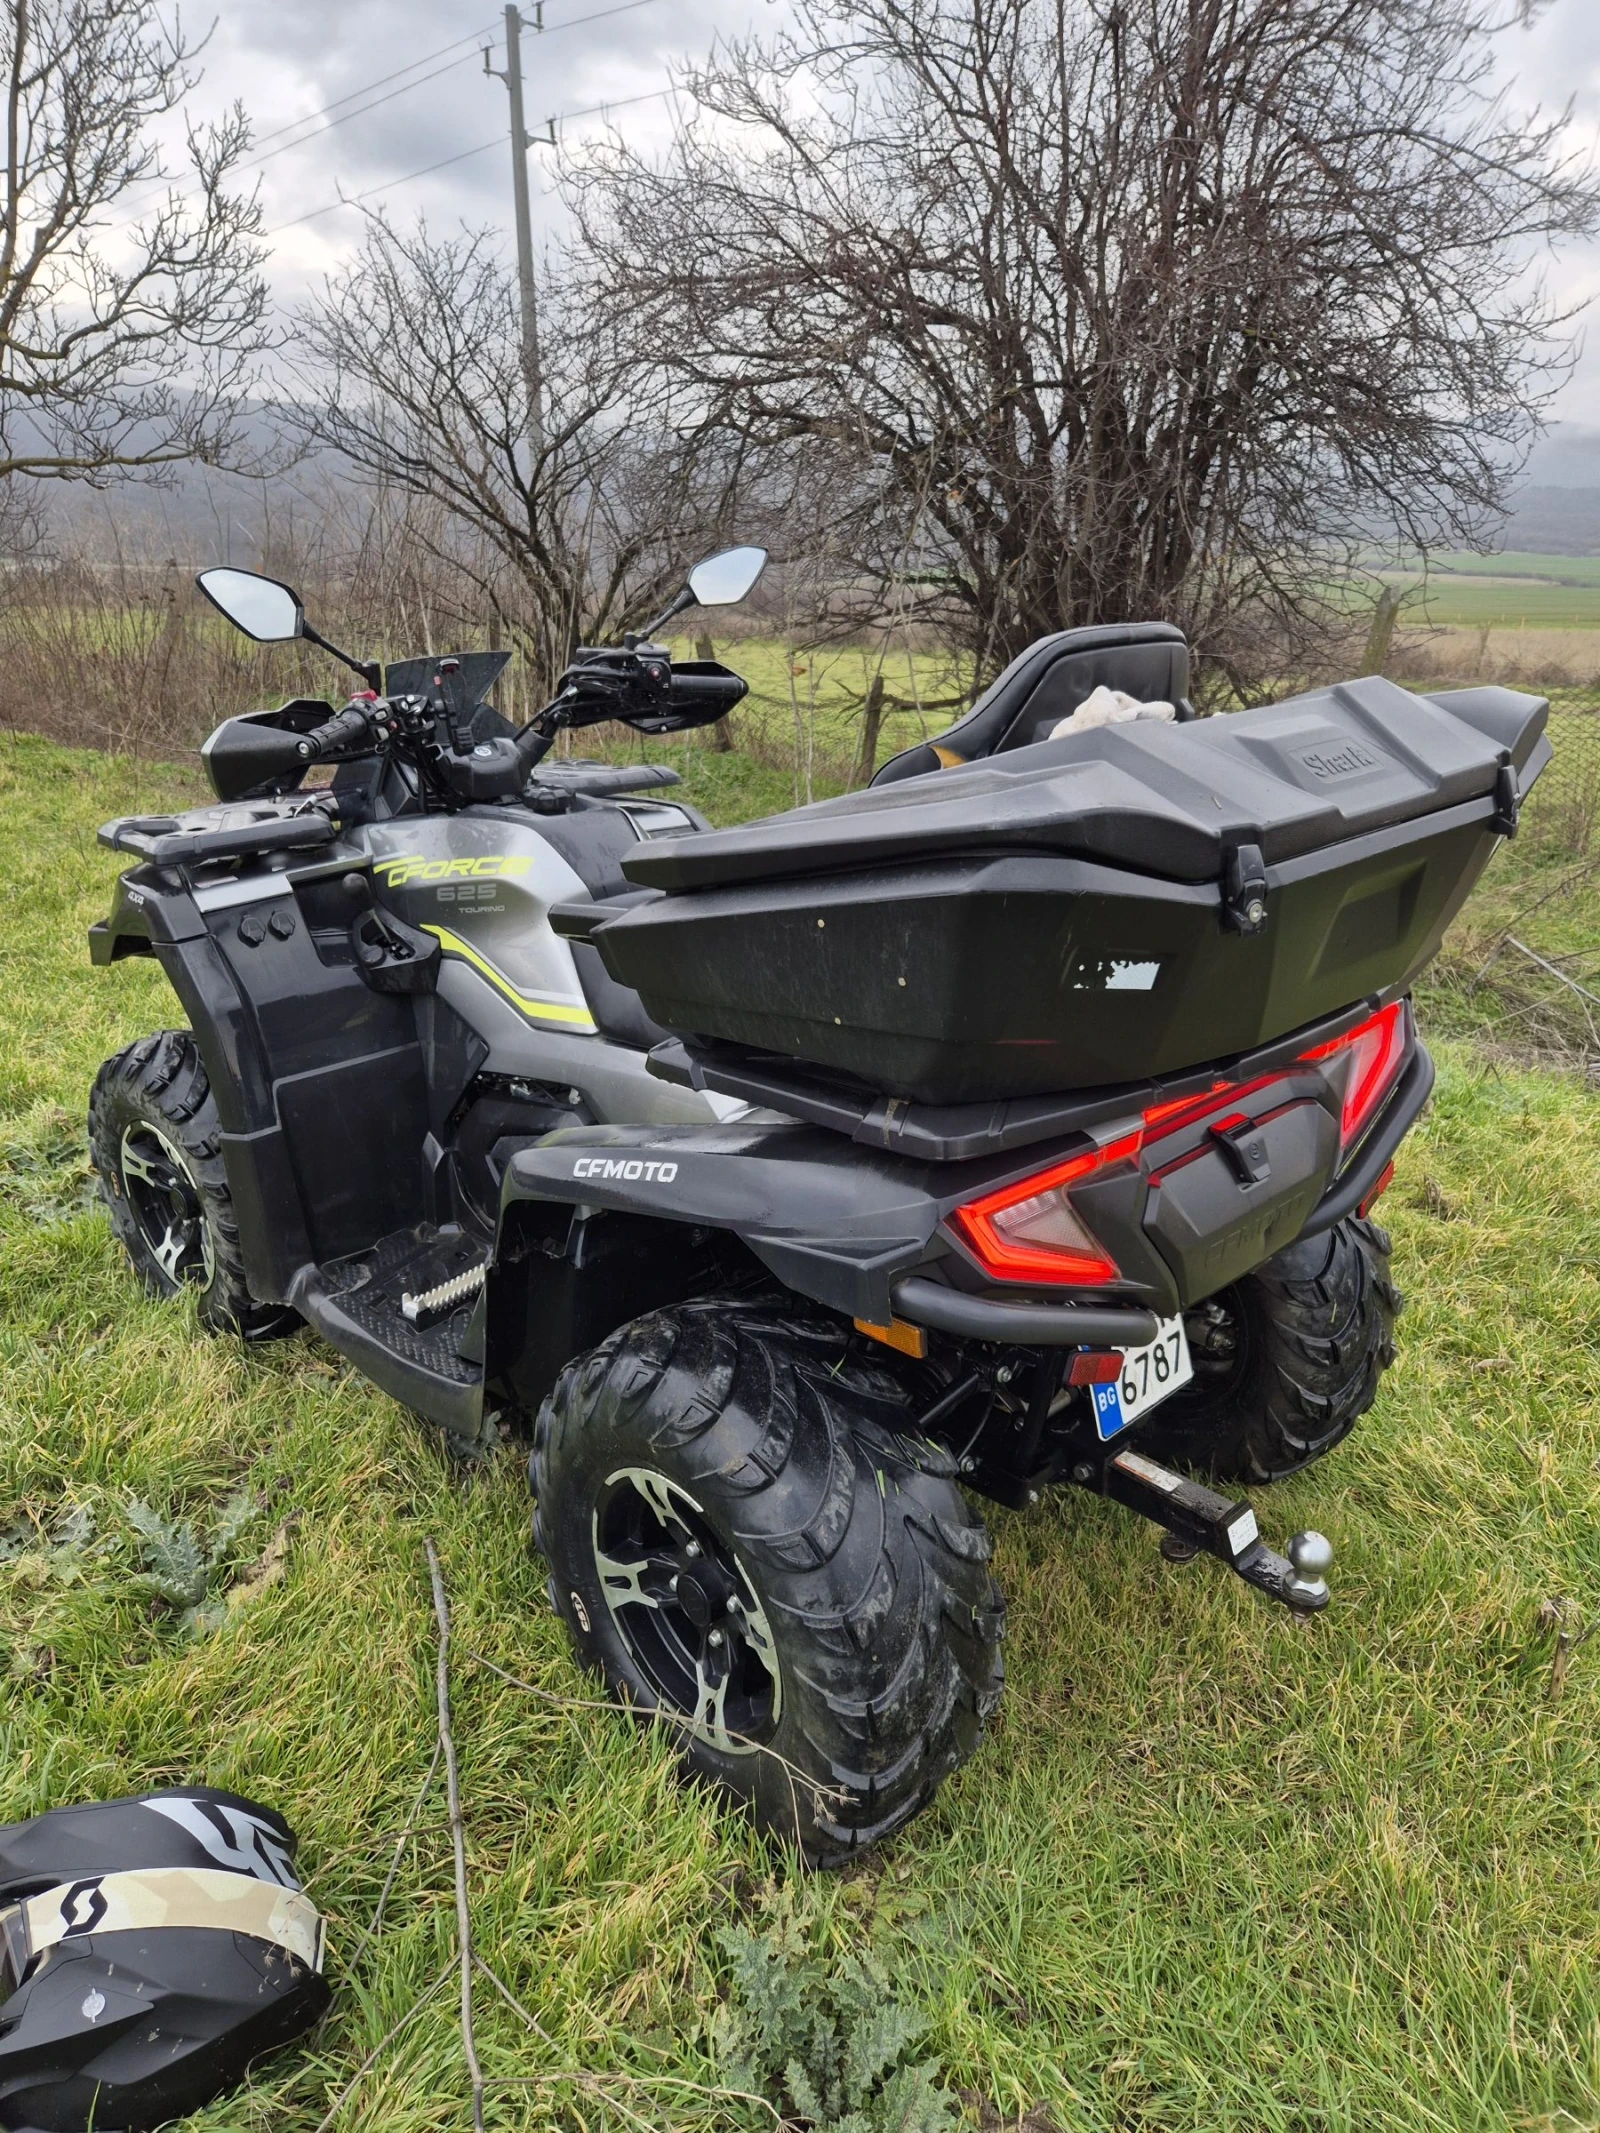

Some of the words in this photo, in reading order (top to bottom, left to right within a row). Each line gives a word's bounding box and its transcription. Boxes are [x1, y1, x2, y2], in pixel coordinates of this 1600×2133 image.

[1302, 746, 1373, 778] Shark
[373, 855, 535, 888] CFORCE
[436, 884, 497, 902] 625
[458, 905, 505, 914] TOURING
[572, 1158, 679, 1183] CFMOTO
[1121, 1329, 1181, 1406] 6787
[1097, 1386, 1117, 1412] BG
